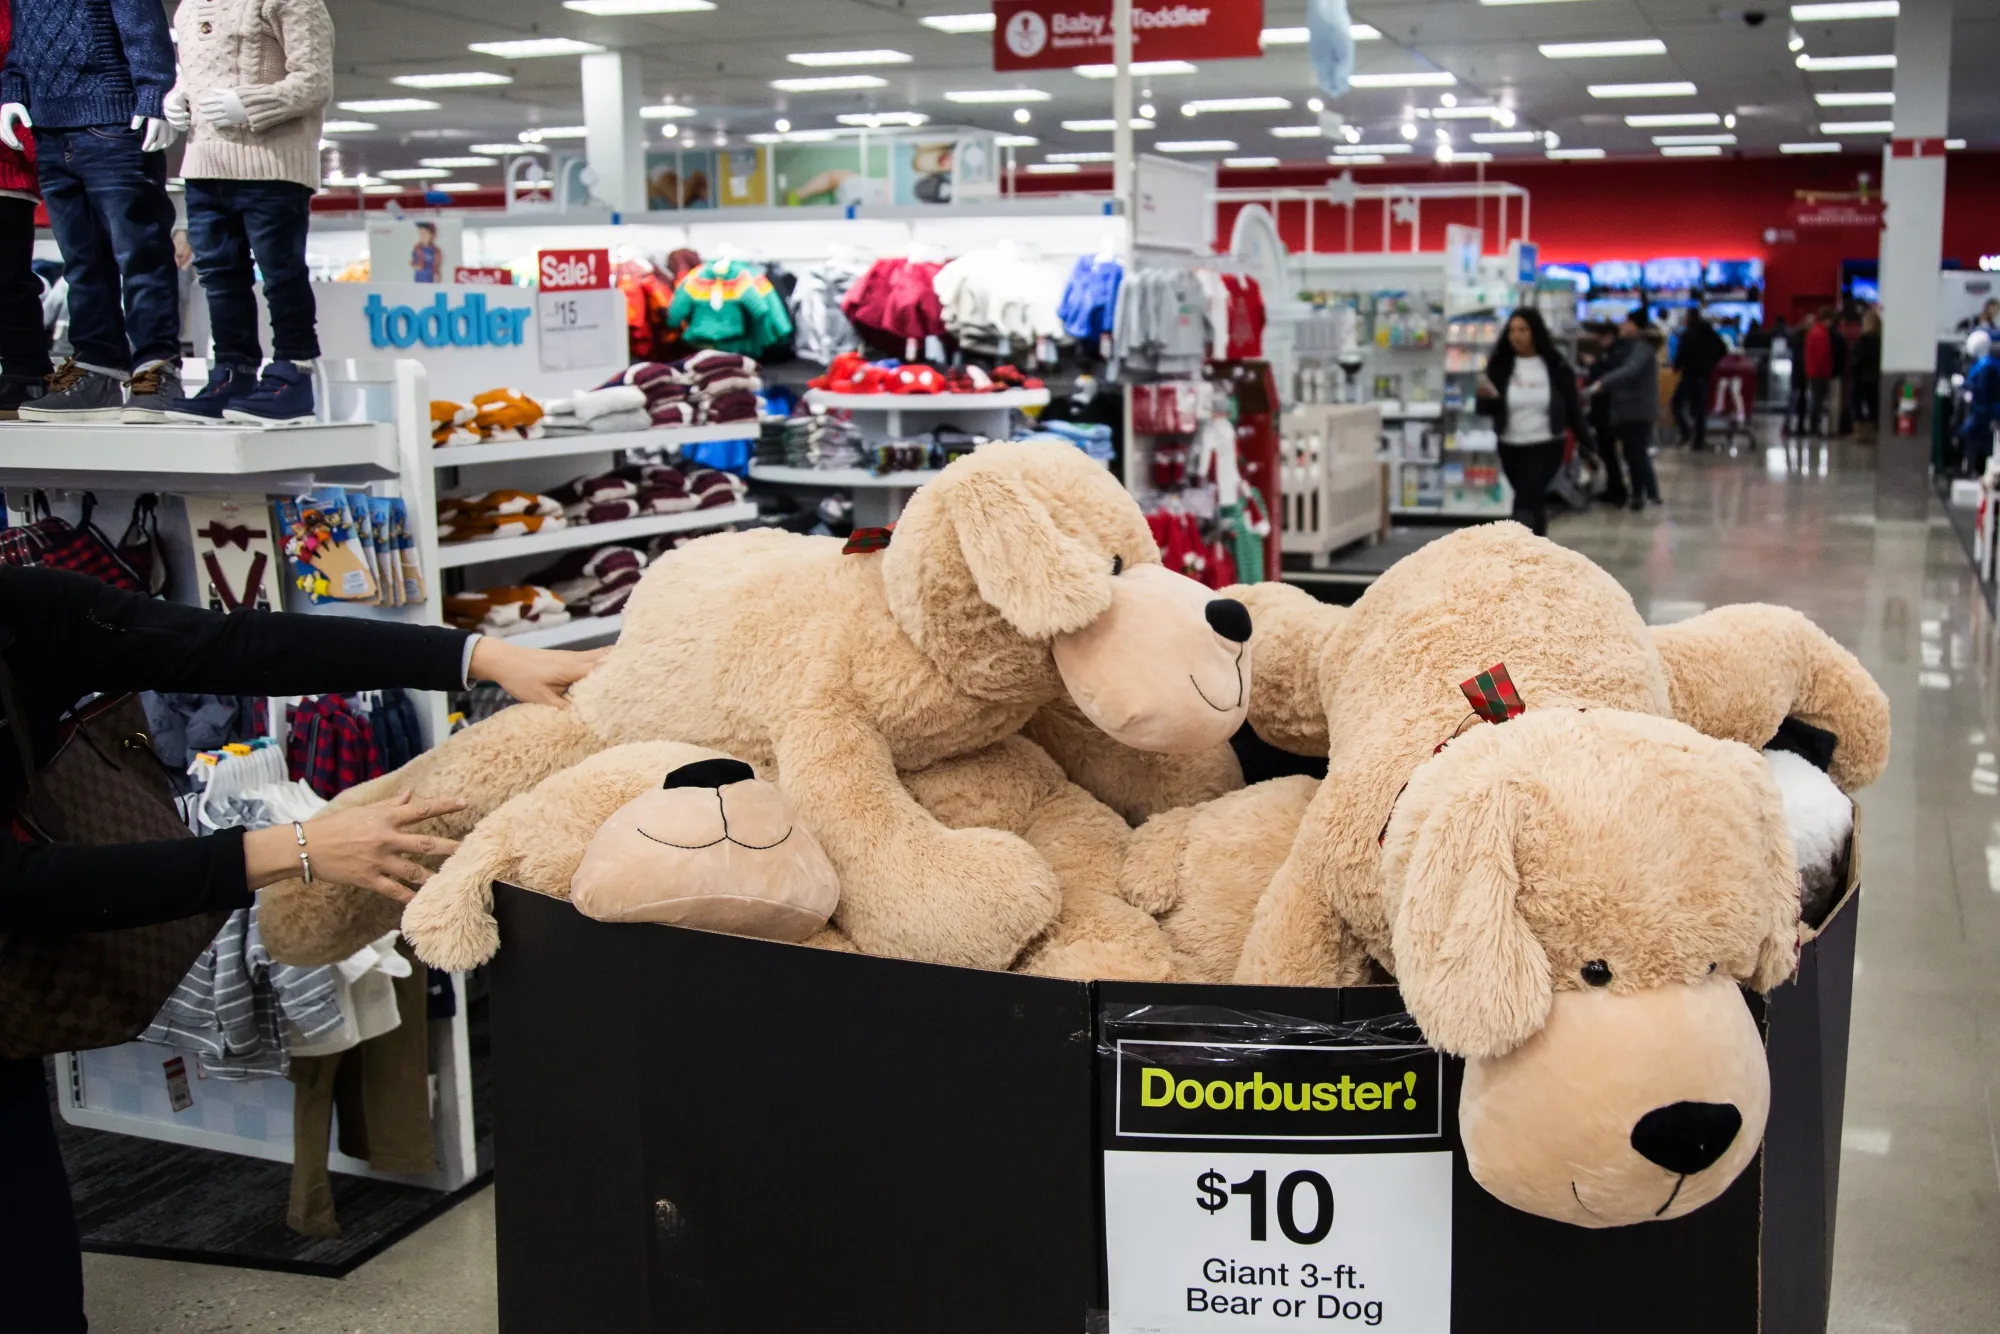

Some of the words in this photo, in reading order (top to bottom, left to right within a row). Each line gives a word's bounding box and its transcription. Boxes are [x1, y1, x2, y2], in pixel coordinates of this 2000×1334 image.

[1052, 12, 1105, 35] Baby
[1131, 6, 1211, 28] Toddler
[541, 253, 597, 288] Sale!
[364, 292, 531, 348] toddler
[1141, 1067, 1417, 1111] Doorbuster!
[1195, 1168, 1335, 1245] $10
[1202, 1258, 1290, 1287] Giant
[1300, 1264, 1366, 1289] 3-ft.
[1186, 1287, 1263, 1316] Bear
[1272, 1298, 1311, 1318] or
[1317, 1295, 1384, 1326] Dog
